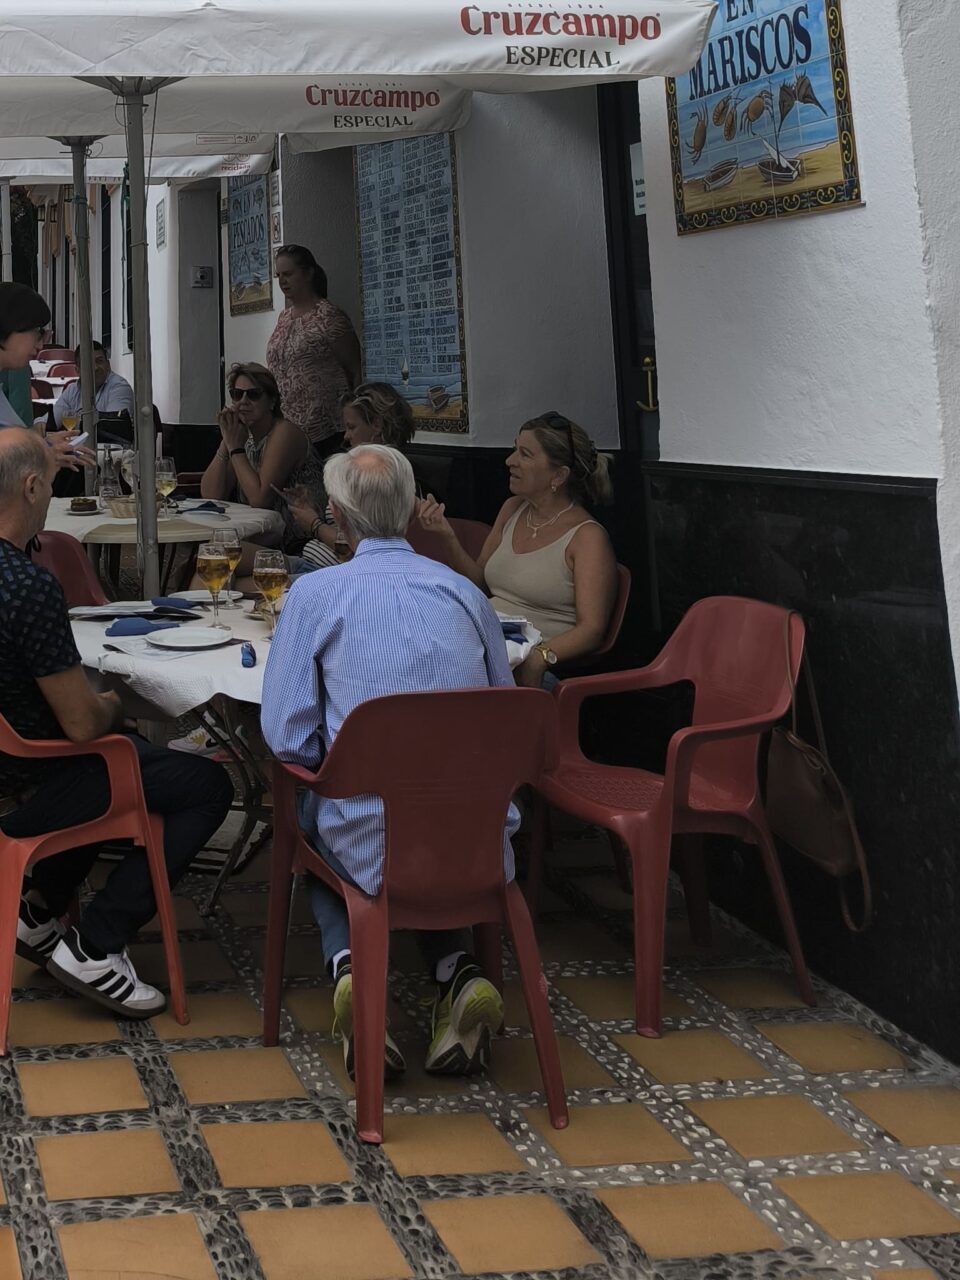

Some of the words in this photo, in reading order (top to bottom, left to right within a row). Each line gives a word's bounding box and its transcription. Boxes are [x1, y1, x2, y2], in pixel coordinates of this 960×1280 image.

[460, 5, 660, 46] Cruzcampo
[505, 45, 620, 69] ESPECIAL
[690, 4, 813, 101] MARISCOS
[305, 84, 440, 112] Cruzcampo
[333, 115, 413, 129] ESPECIAL
